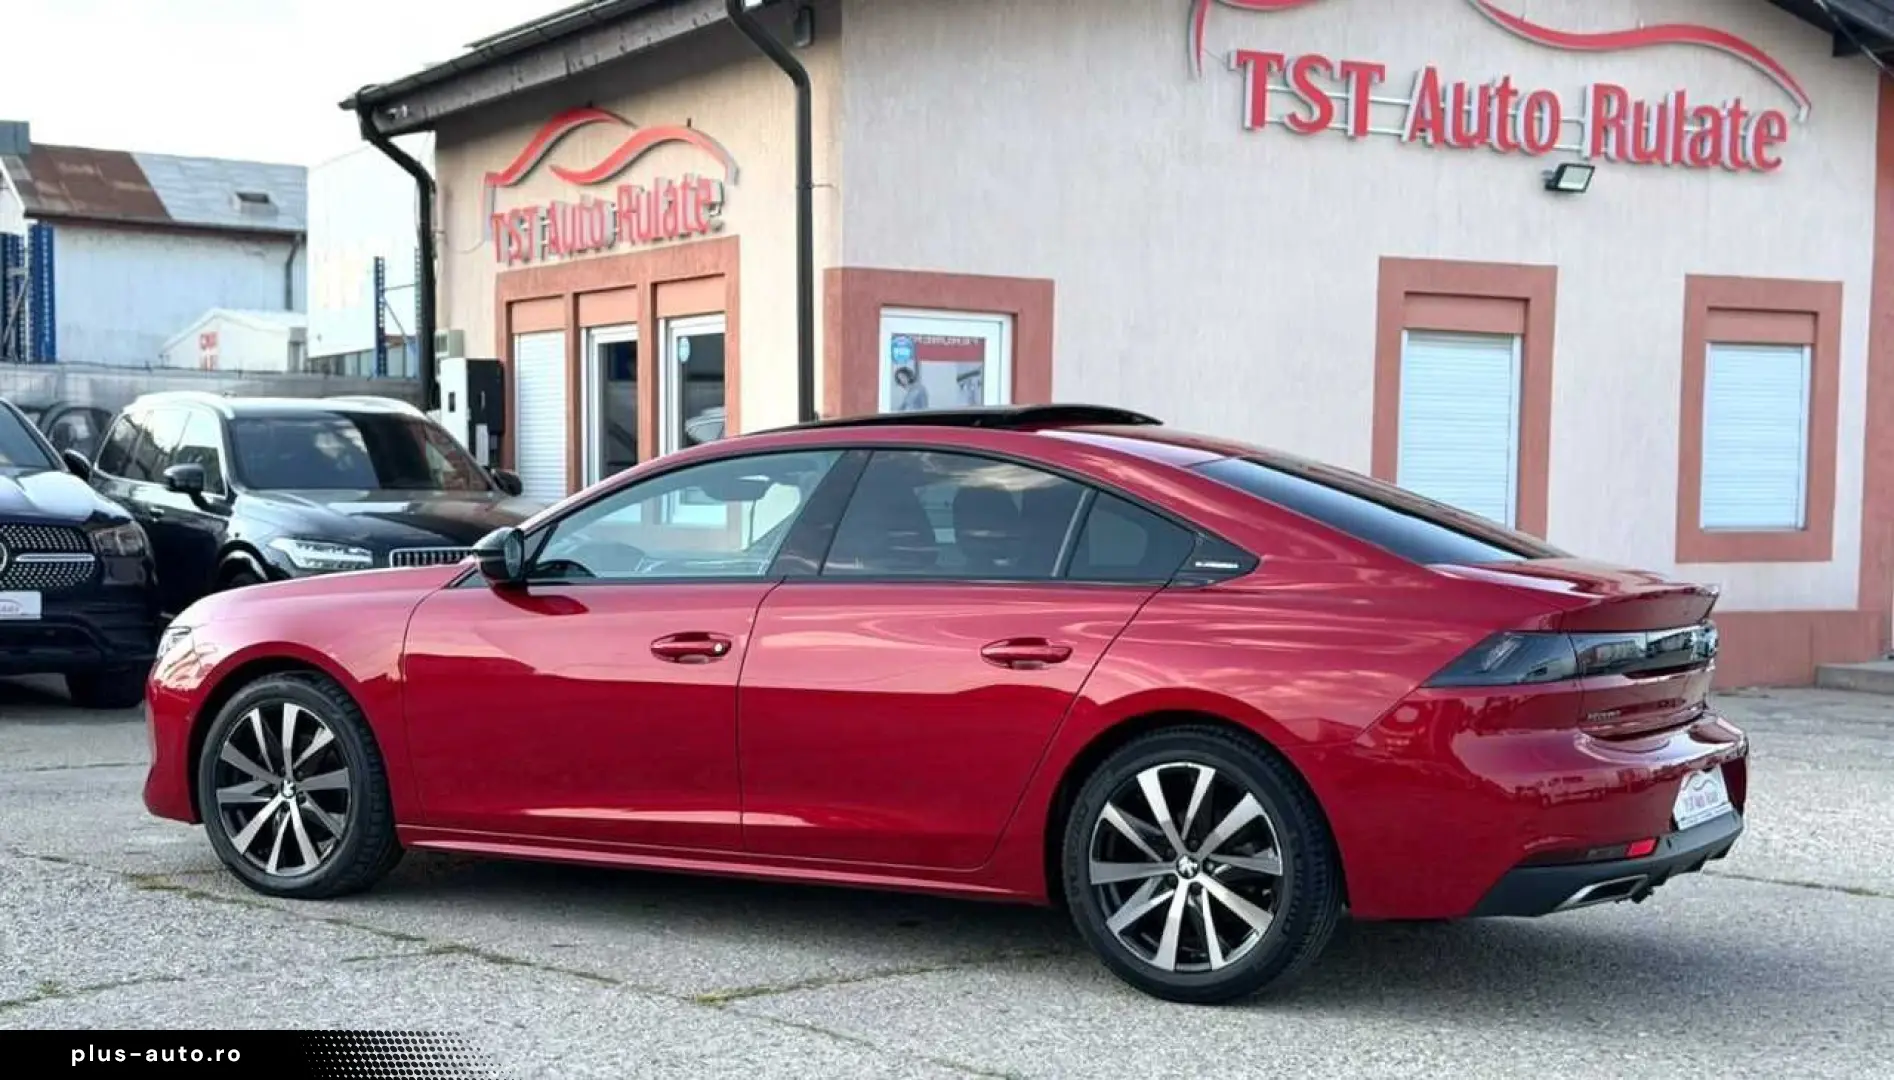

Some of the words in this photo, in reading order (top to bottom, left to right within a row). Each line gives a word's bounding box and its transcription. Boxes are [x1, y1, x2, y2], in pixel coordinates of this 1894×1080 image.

[1235, 48, 1386, 139] TST
[1405, 66, 1562, 156] Auto
[1588, 82, 1788, 172] Rulate
[491, 205, 542, 263] TST
[548, 195, 608, 256] Auto
[616, 173, 713, 245] Rulate
